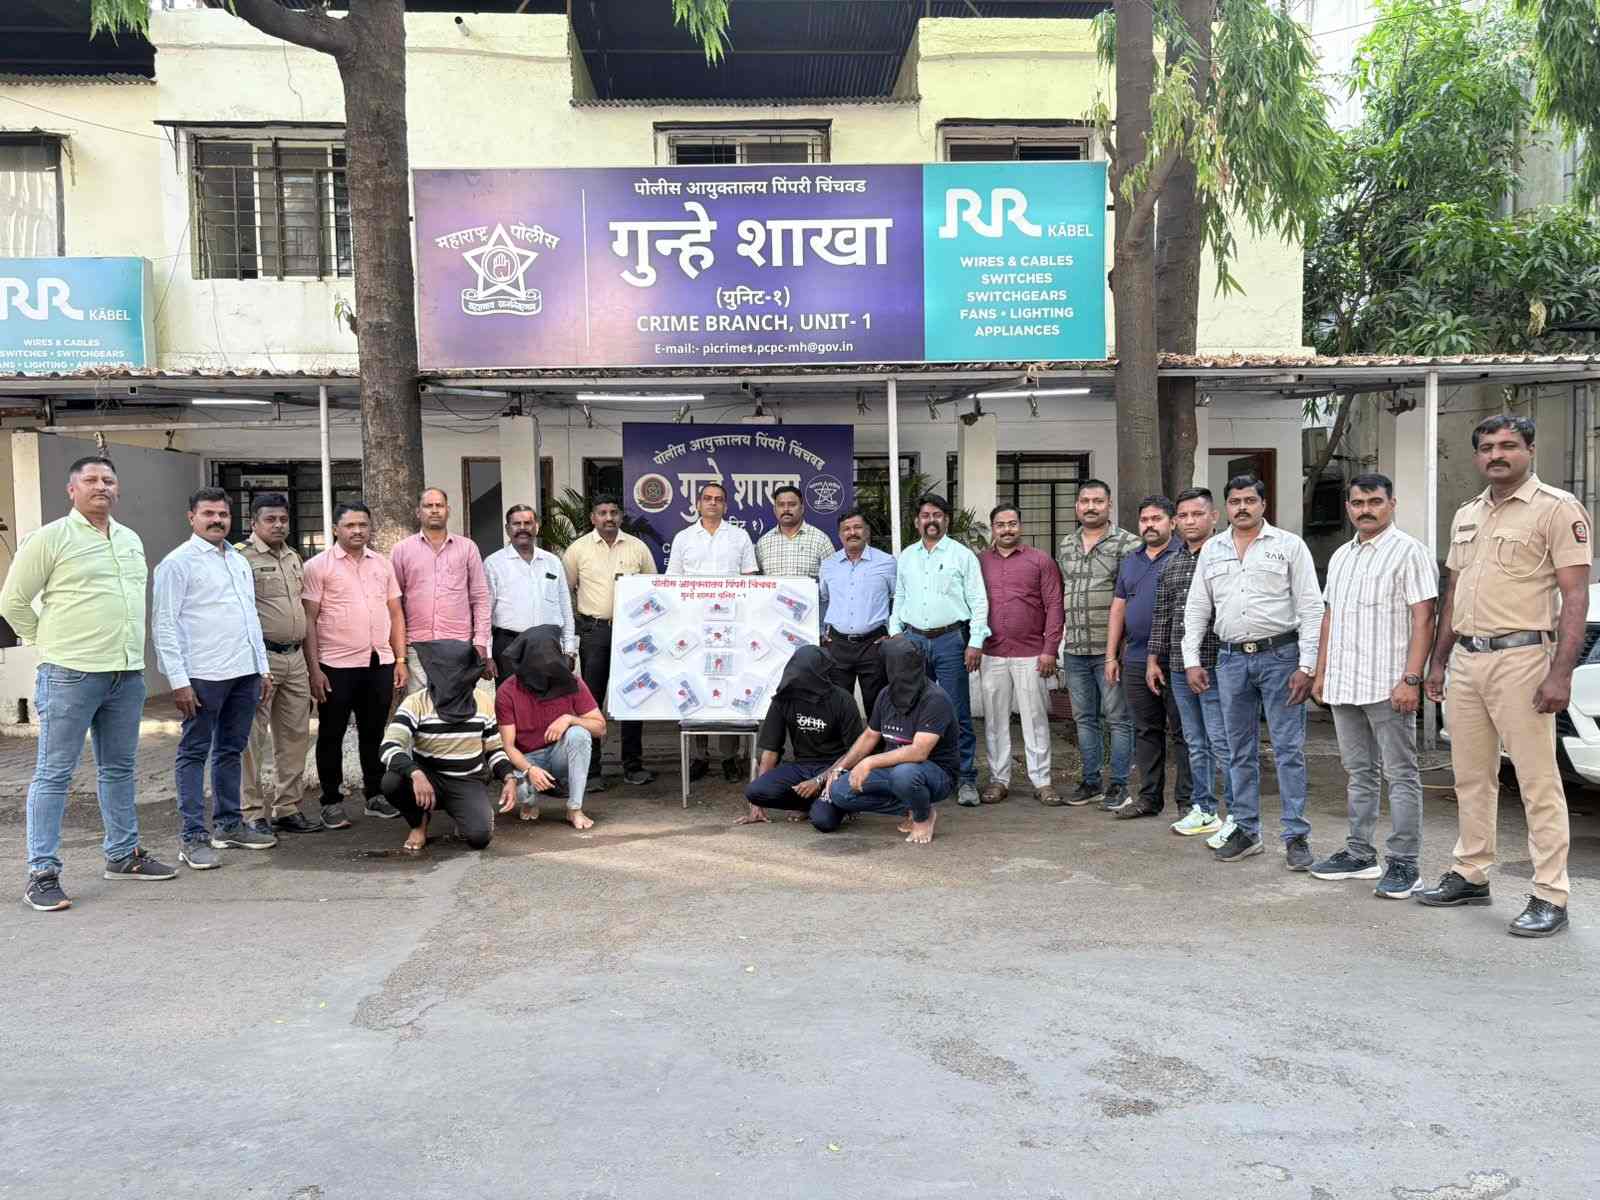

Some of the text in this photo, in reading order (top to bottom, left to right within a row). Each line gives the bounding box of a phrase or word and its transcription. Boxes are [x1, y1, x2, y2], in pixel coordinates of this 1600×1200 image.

[634, 175, 867, 199] पोलीस आयुक्तालय पिंपरी चिंचवड
[938, 187, 1042, 239] RR
[434, 222, 561, 250] महाराष्ट्र पोलीस
[608, 201, 894, 288] गुन्हे शाखा
[960, 255, 1074, 268] WIRES & CABLES
[981, 272, 1053, 285] SWITCHES
[966, 290, 1068, 302] SWITCHGEARS
[959, 307, 1074, 320] FANS LIGHTING
[637, 313, 872, 333] CRIME BRANCH, UNIT- 1
[974, 324, 1060, 337] APPLIANCES
[23, 338, 53, 347] WIRES
[63, 338, 101, 347] CABLES
[56, 350, 125, 358] SWITCHGEARS
[23, 361, 68, 369] LIGHTING
[653, 443, 687, 466] पोलीस
[755, 431, 786, 452] पिंपरी
[788, 439, 826, 471] चिंचवड
